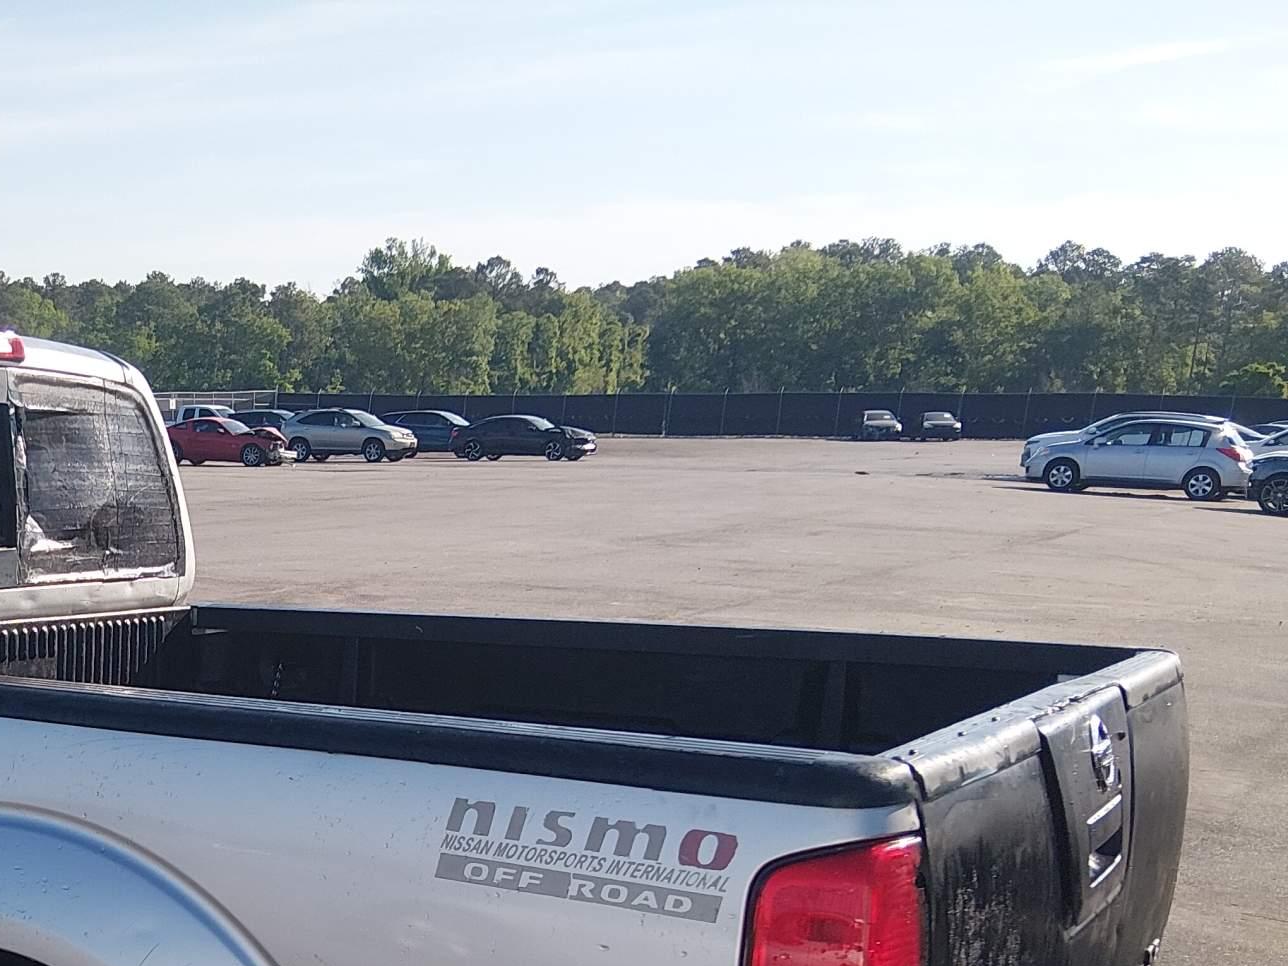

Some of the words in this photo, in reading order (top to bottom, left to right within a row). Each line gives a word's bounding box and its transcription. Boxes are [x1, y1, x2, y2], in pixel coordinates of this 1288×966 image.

[440, 834, 494, 855] NISSAN
[493, 842, 606, 872] MOTORSPORTS
[604, 859, 730, 892] INTERNATIONAL
[464, 862, 544, 888] OFF
[567, 878, 692, 913] ROAD
